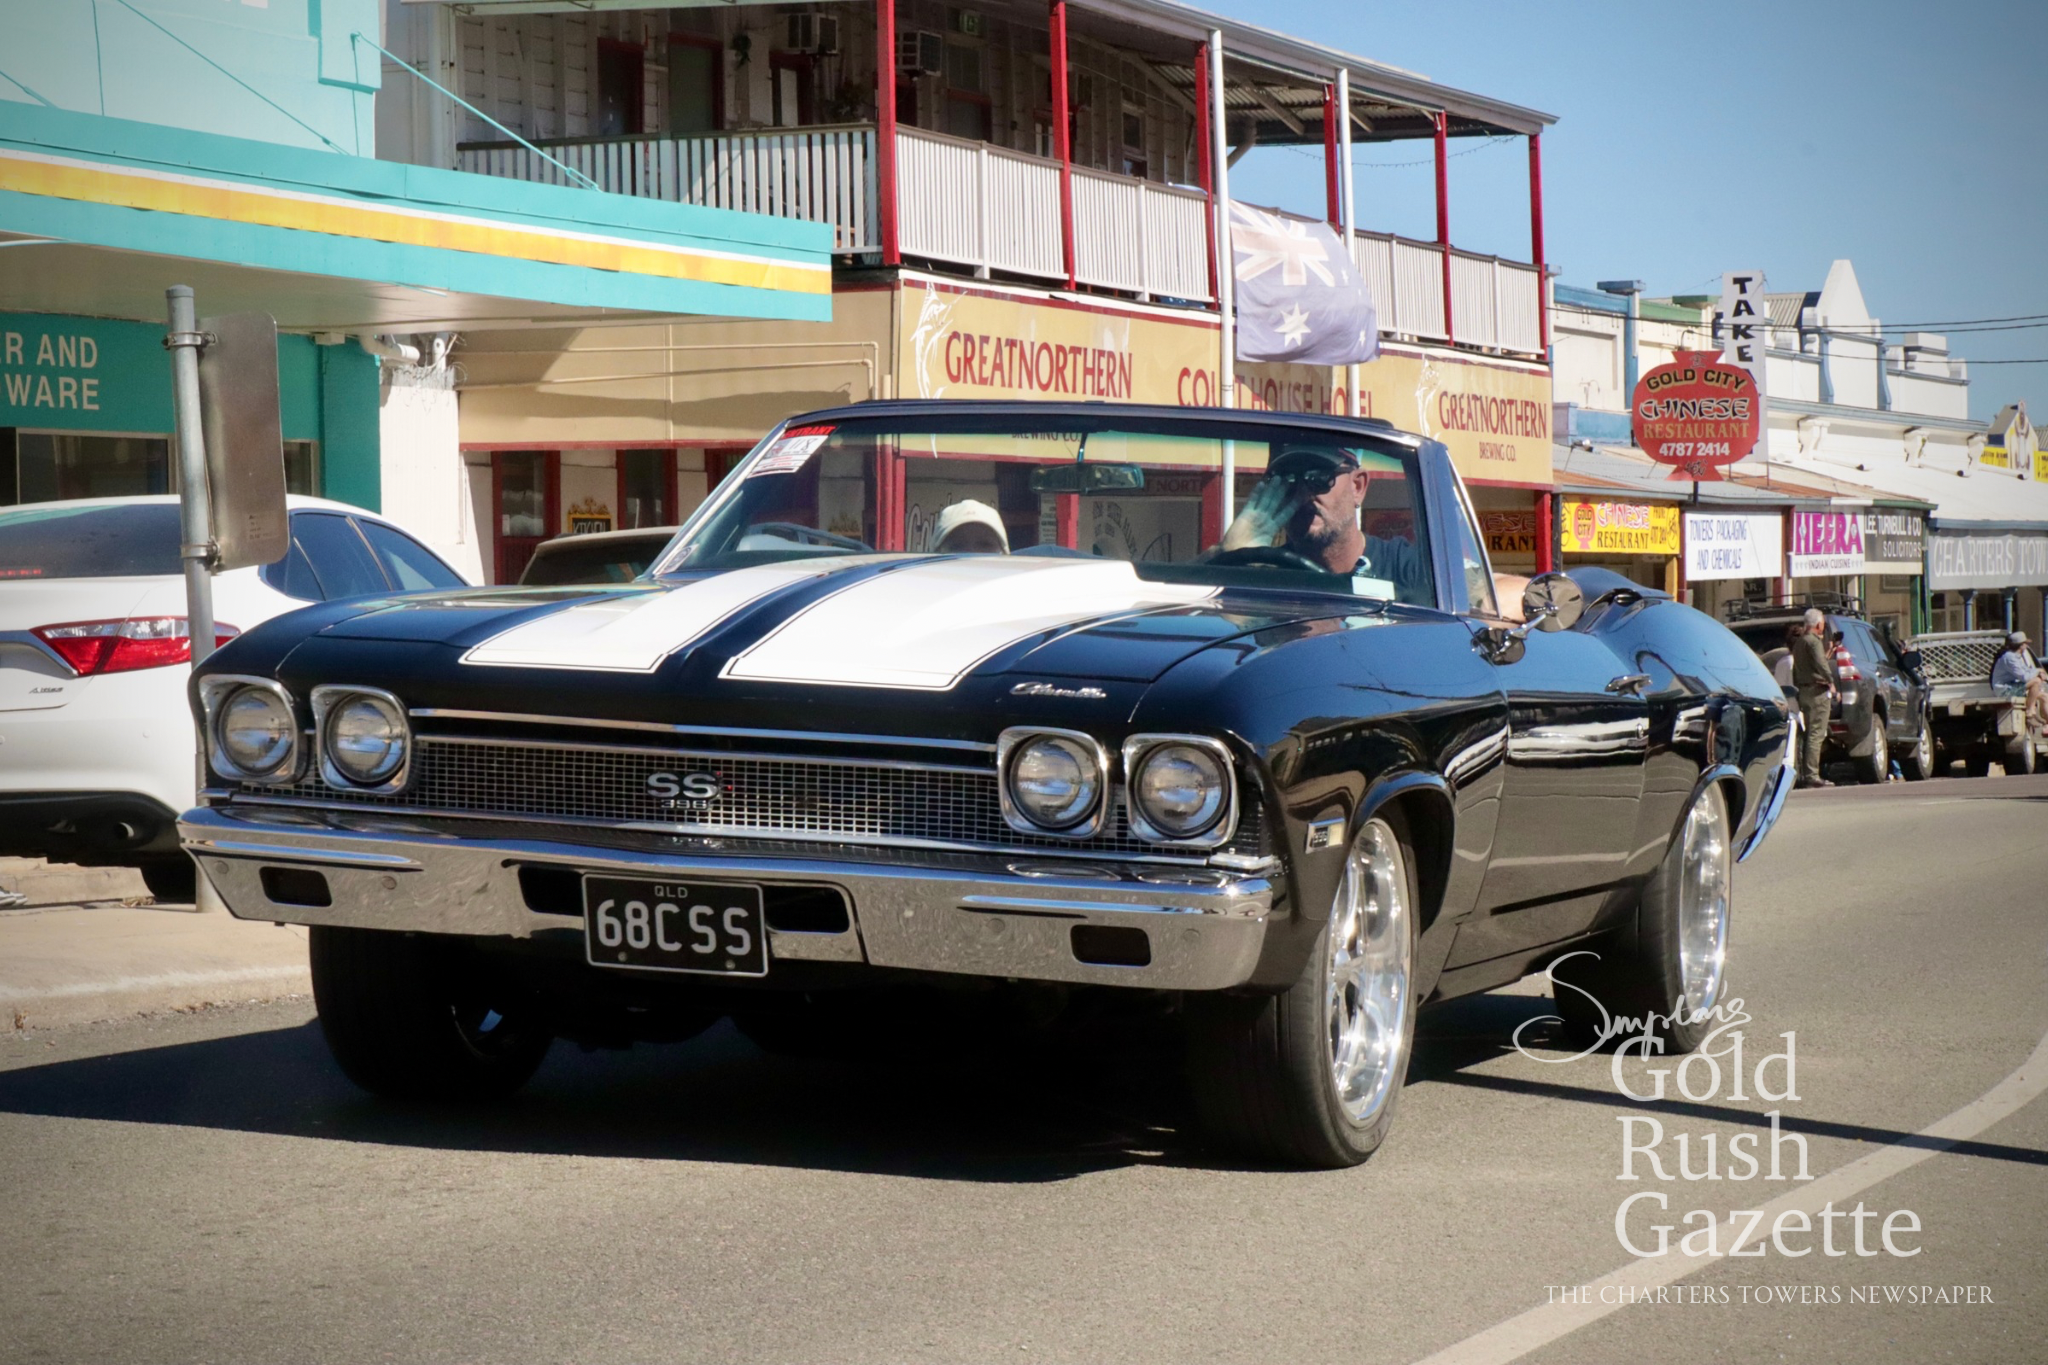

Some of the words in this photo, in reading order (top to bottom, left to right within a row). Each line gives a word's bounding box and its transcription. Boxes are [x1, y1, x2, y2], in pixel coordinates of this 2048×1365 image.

[36, 333, 98, 369] AND
[1646, 368, 1698, 393] GOLD
[1703, 368, 1748, 394] CITY
[1639, 397, 1750, 421] CHINESE
[1643, 422, 1750, 439] RESTAURANT
[1479, 441, 1504, 461] BREWING
[1659, 442, 1693, 457] 4787
[1696, 441, 1730, 457] 2414
[1577, 508, 1592, 521] GOLD
[1597, 501, 1650, 530] CHINESE
[1577, 523, 1591, 536] CITY
[1597, 531, 1649, 549] RESTAURANT
[1794, 511, 1864, 555] HEERA
[1697, 549, 1709, 570] AND
[1711, 548, 1742, 570] CHEMICALS
[1882, 541, 1921, 558] SOLICITORS
[1933, 538, 2014, 578] CHARTERS
[2018, 538, 2048, 576] TOW
[1808, 559, 1829, 569] INDIAN
[1830, 558, 1851, 569] CUISINE
[647, 772, 720, 798] SS
[654, 885, 688, 899] QLD
[596, 899, 752, 956] 68CSS
